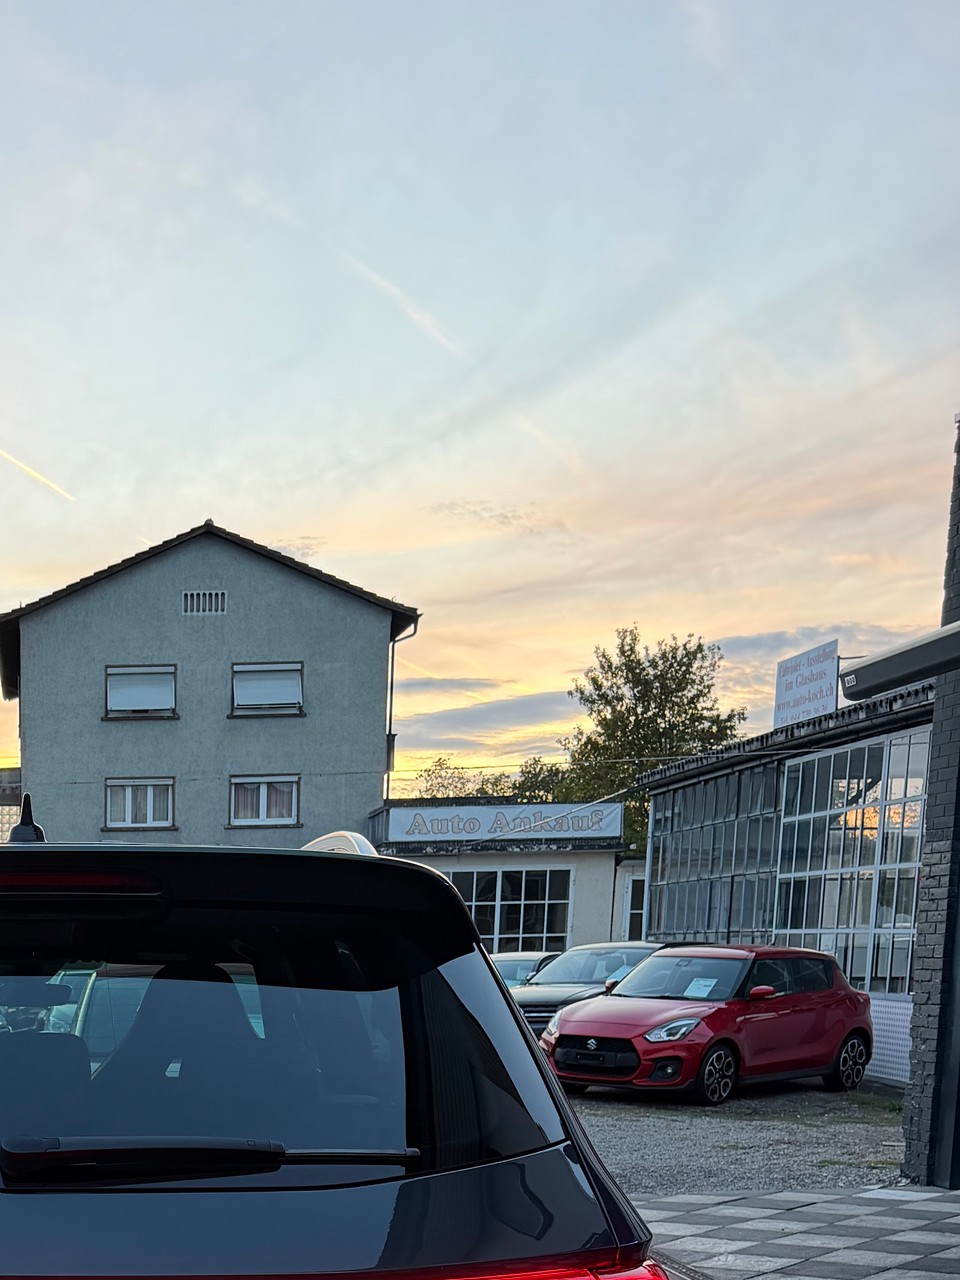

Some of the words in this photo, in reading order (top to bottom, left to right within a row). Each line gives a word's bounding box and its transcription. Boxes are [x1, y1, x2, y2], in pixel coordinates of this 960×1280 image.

[785, 679, 793, 692] im
[796, 669, 826, 688] Glashaus
[777, 683, 834, 712] www.auto-koch.ch
[406, 813, 481, 835] Auto
[487, 810, 604, 833] Ankauf
